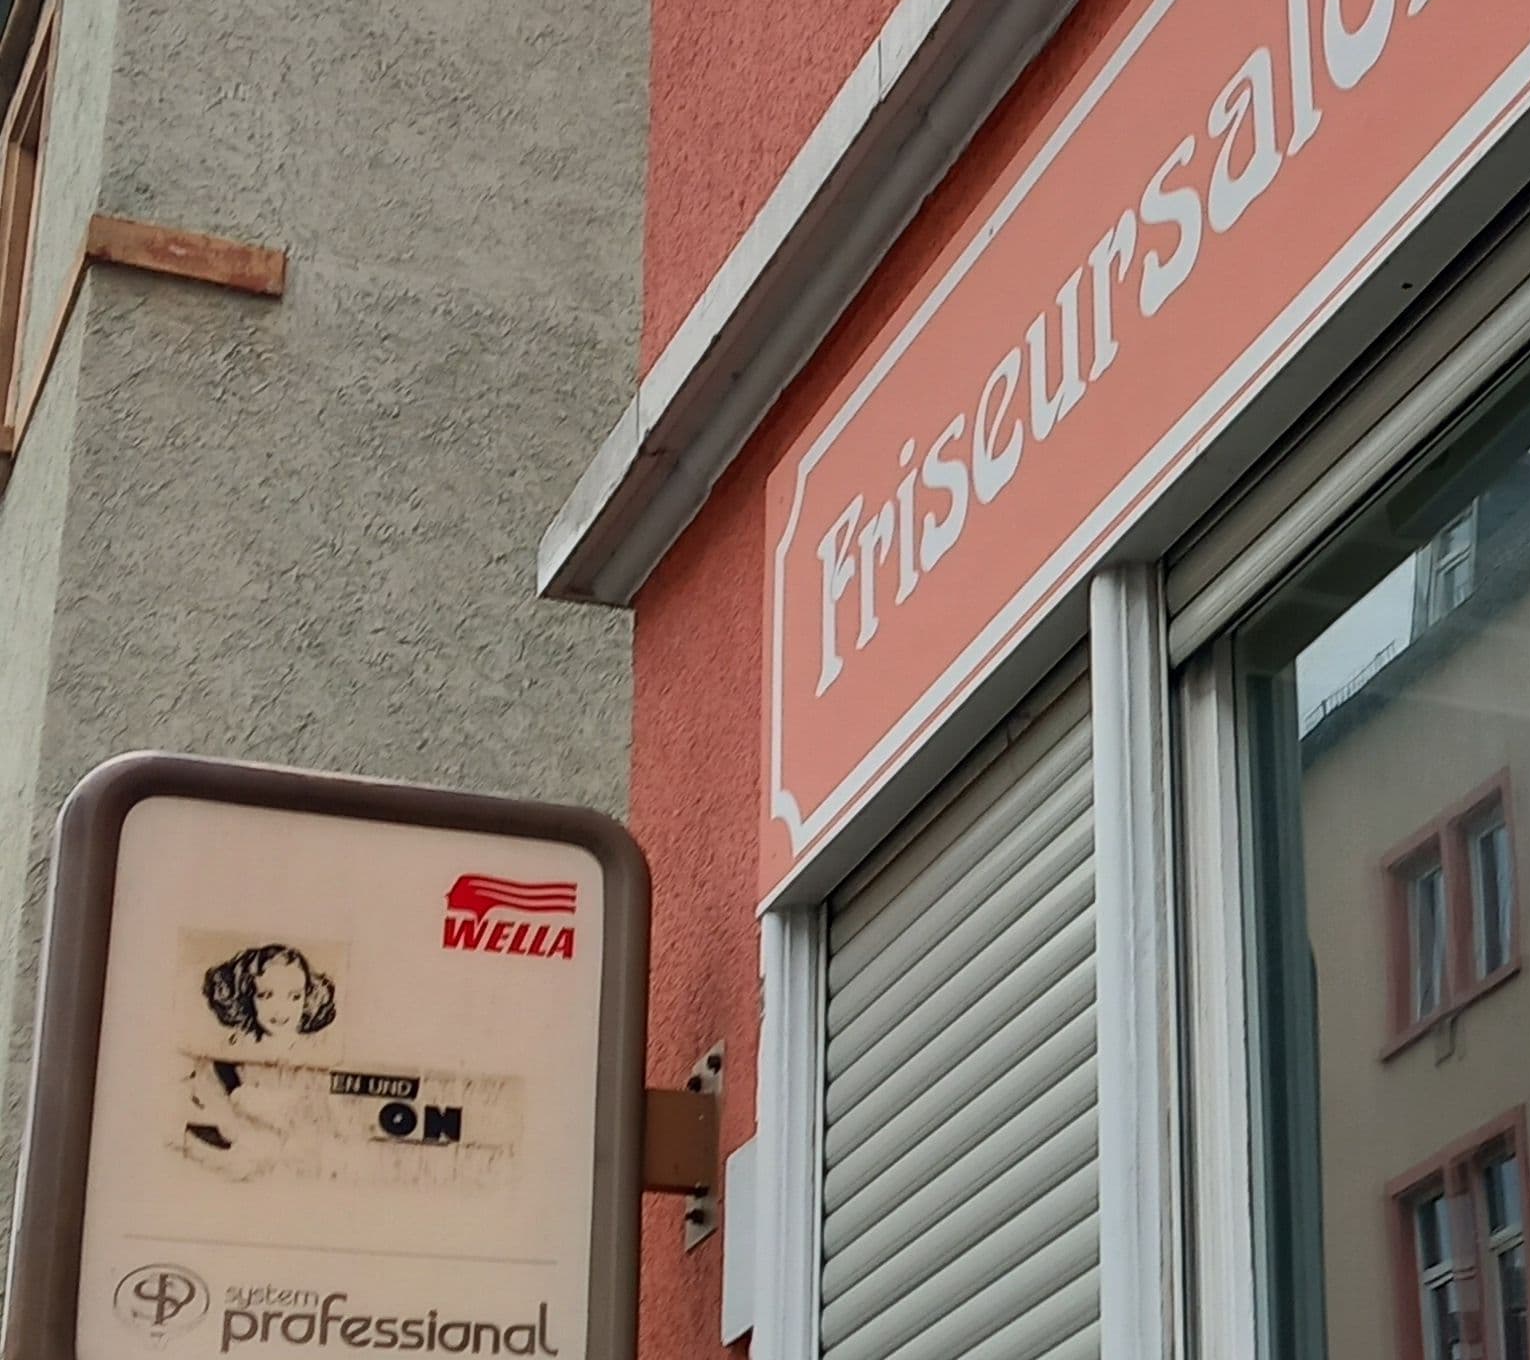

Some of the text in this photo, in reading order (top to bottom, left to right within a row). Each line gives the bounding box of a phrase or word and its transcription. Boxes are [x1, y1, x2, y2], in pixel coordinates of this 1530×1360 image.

[442, 916, 576, 960] WELLA
[368, 1077, 413, 1097] UND
[379, 1101, 463, 1142] ON
[226, 1281, 320, 1315] system
[221, 1293, 559, 1358] professional
